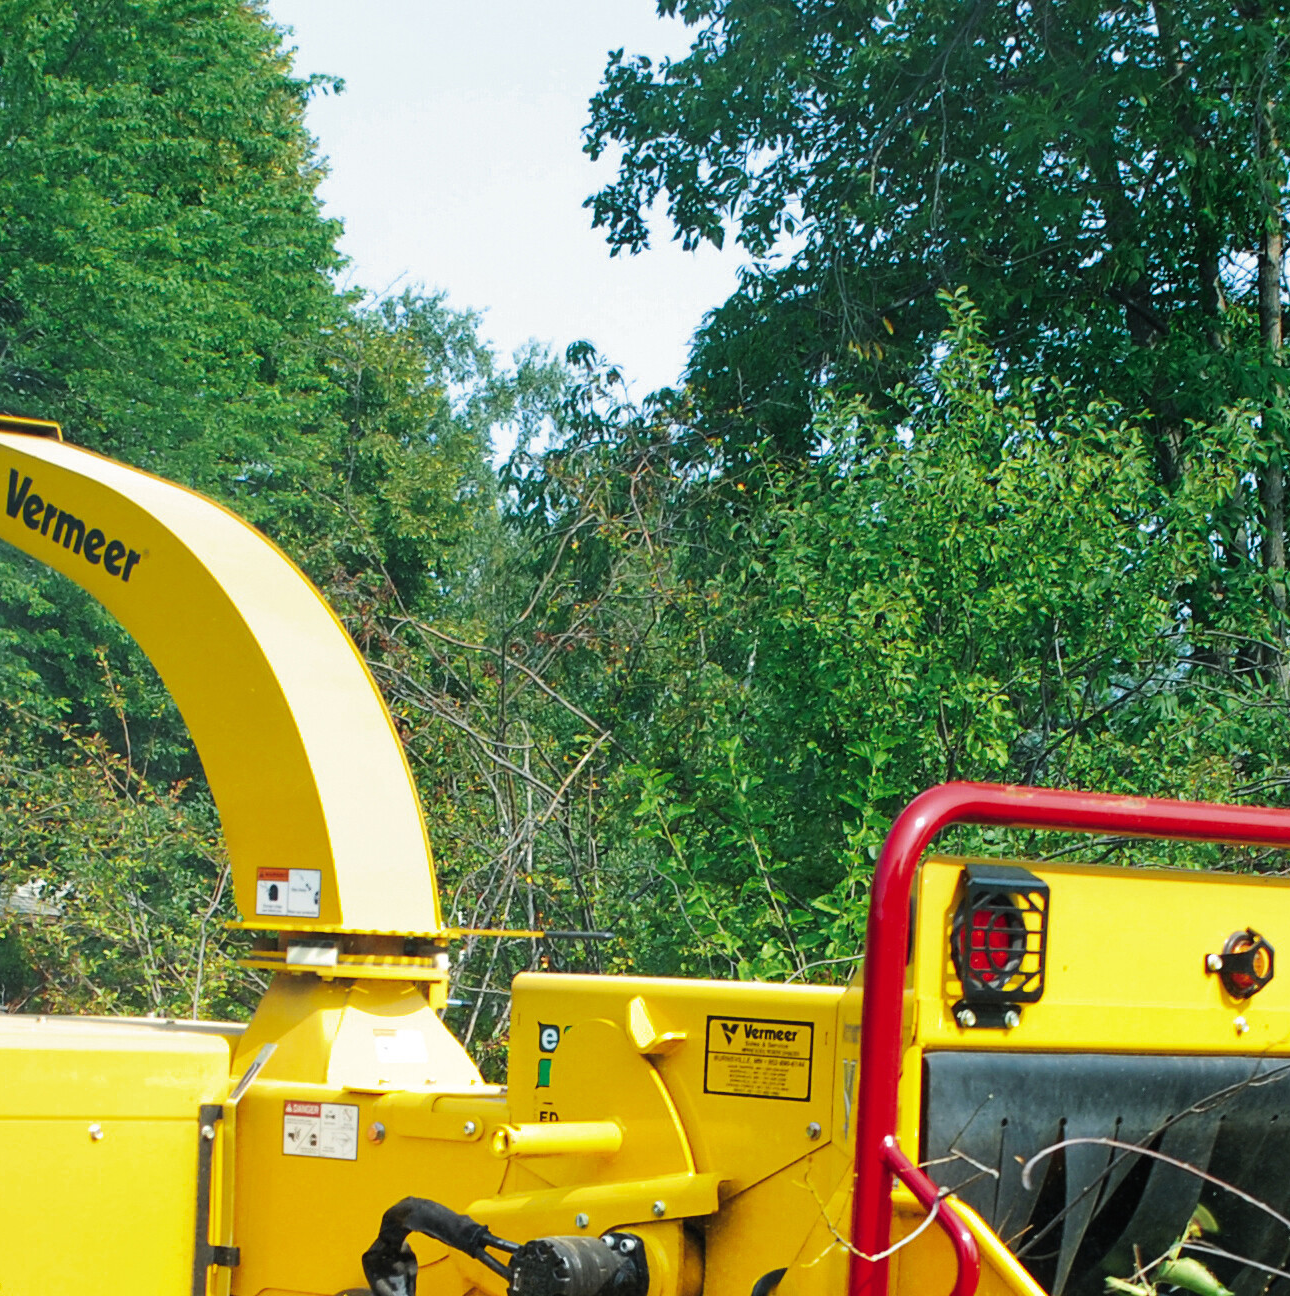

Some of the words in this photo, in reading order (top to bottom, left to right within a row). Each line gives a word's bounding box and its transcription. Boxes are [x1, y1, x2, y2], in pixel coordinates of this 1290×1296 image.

[6, 468, 141, 582] Vermeer
[744, 1023, 798, 1042] Vermeer
[293, 1104, 319, 1114] DANGER
